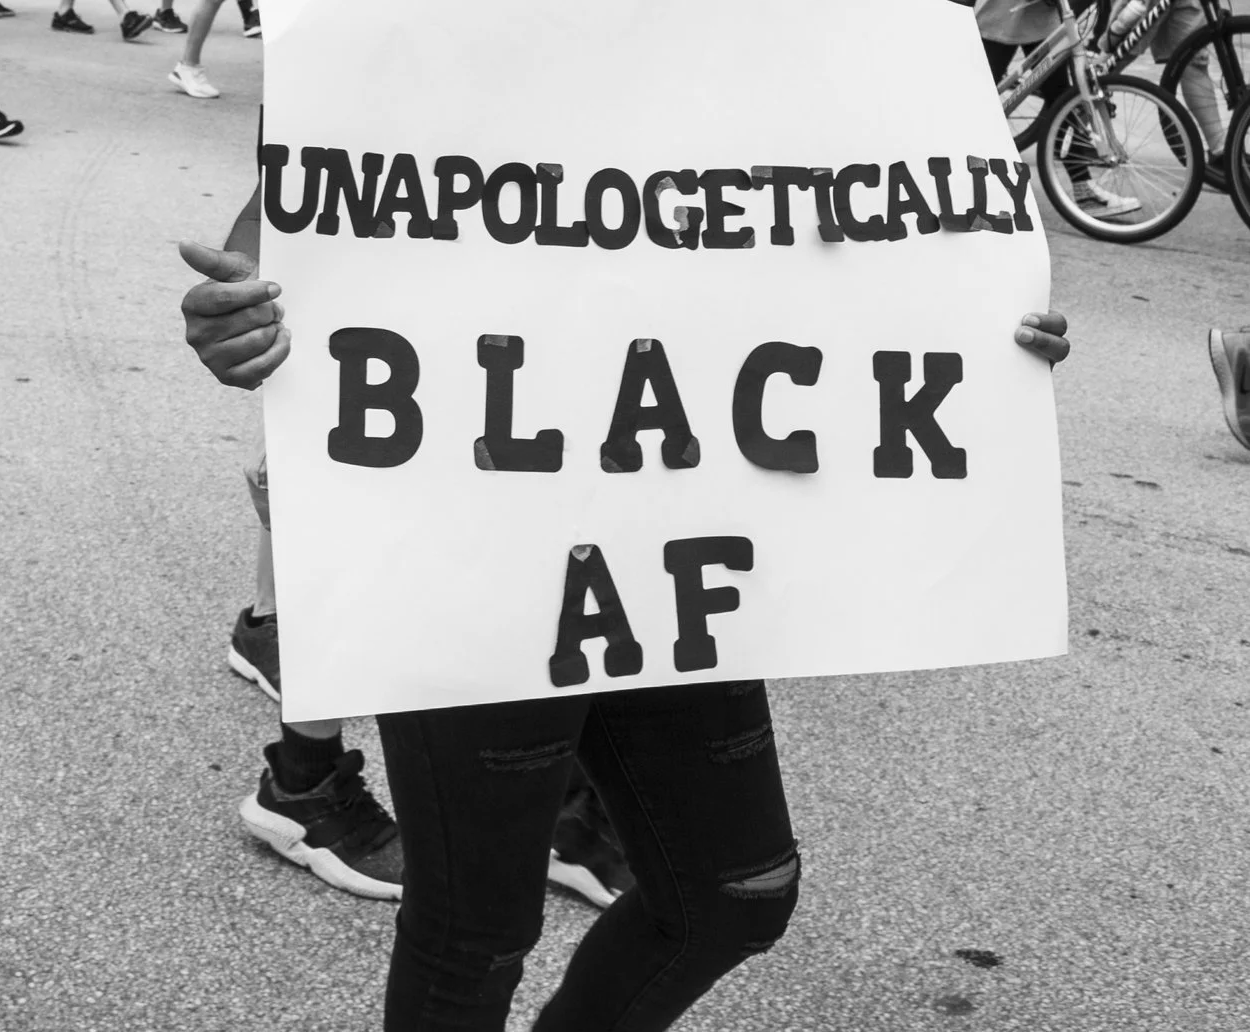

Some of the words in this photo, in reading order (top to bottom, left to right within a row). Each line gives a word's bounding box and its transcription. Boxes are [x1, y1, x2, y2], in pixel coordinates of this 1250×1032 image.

[260, 143, 1034, 250] UNAPOLOGETICALLY
[328, 328, 967, 479] BLACK
[549, 536, 753, 687] AF
